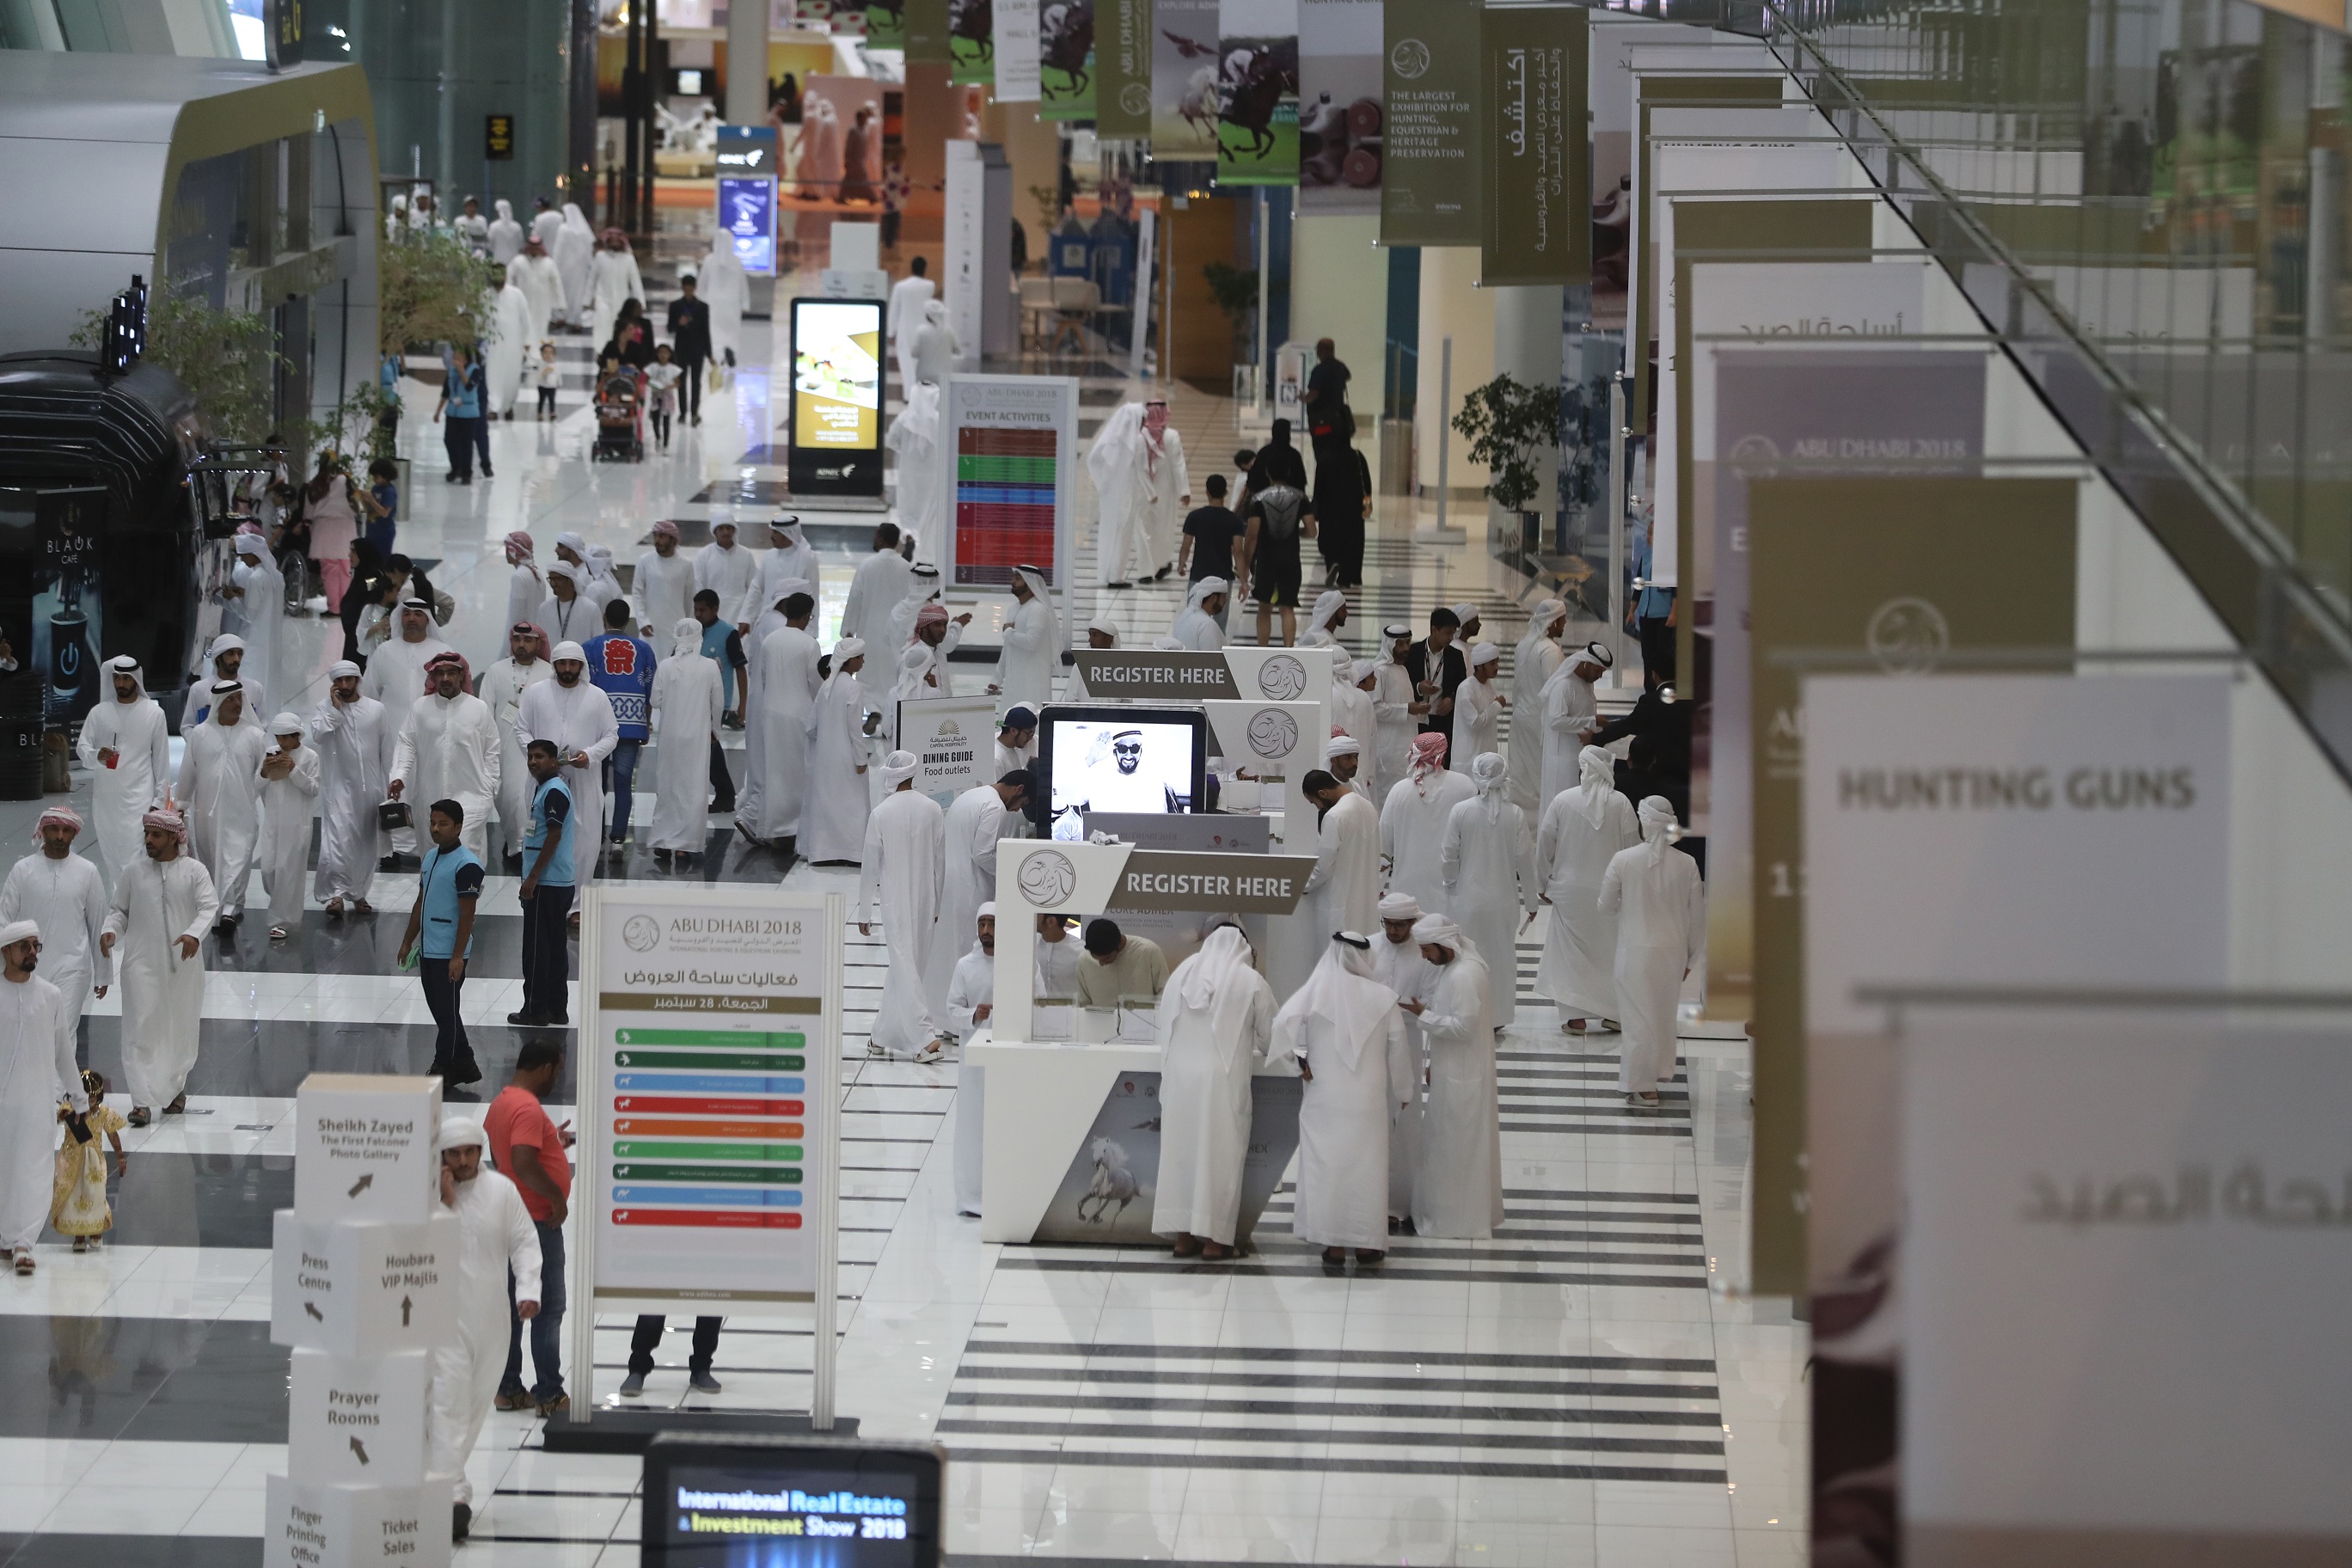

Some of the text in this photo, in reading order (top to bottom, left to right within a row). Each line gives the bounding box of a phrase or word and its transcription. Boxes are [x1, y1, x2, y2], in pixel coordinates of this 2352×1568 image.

[1392, 91, 1455, 101] THE LARGEST
[1504, 48, 1526, 156] اكتشف
[1391, 103, 1470, 112] EXHIBITION FOR
[1391, 114, 1439, 125] HUNTING,
[1391, 126, 1459, 136] EQUESTRIAN &
[1391, 138, 1439, 146] HERITAGE
[1391, 149, 1465, 158] PRESERVATION
[1037, 389, 1057, 398] 2018
[966, 412, 1050, 422] EVENT ACTIVITIES
[1794, 438, 1966, 458] ABU DHABI 2018
[1090, 666, 1225, 684] REGISTER HERE
[922, 750, 973, 764] DINING GUIDE
[924, 765, 971, 775] Food outlets
[1838, 765, 2196, 811] HUNTING GUNS
[1128, 873, 1291, 897] REGISTER HERE
[671, 918, 802, 935] ABU DHABI 2018
[624, 970, 799, 988] فعاليات ساحة العروض
[700, 998, 714, 1008] 28
[318, 1119, 413, 1136] Sheikh Zayed
[321, 1136, 410, 1147] The First Falconer
[330, 1148, 400, 1161] Photo Gallery
[302, 1253, 328, 1271] Press
[386, 1253, 435, 1270] Houbara
[298, 1274, 332, 1291] Centre
[382, 1271, 438, 1289] VIP Majlis
[329, 1389, 380, 1408] Prayer
[328, 1410, 380, 1425] Rooms
[677, 1486, 906, 1516] International Real Estate
[291, 1506, 322, 1527] Finger
[382, 1519, 419, 1536] Ticket
[691, 1511, 804, 1535] Investment
[805, 1515, 857, 1537] Show
[861, 1516, 907, 1540] 2018
[286, 1524, 326, 1548] Printing
[291, 1546, 320, 1565] Office
[383, 1540, 415, 1556] Sales
